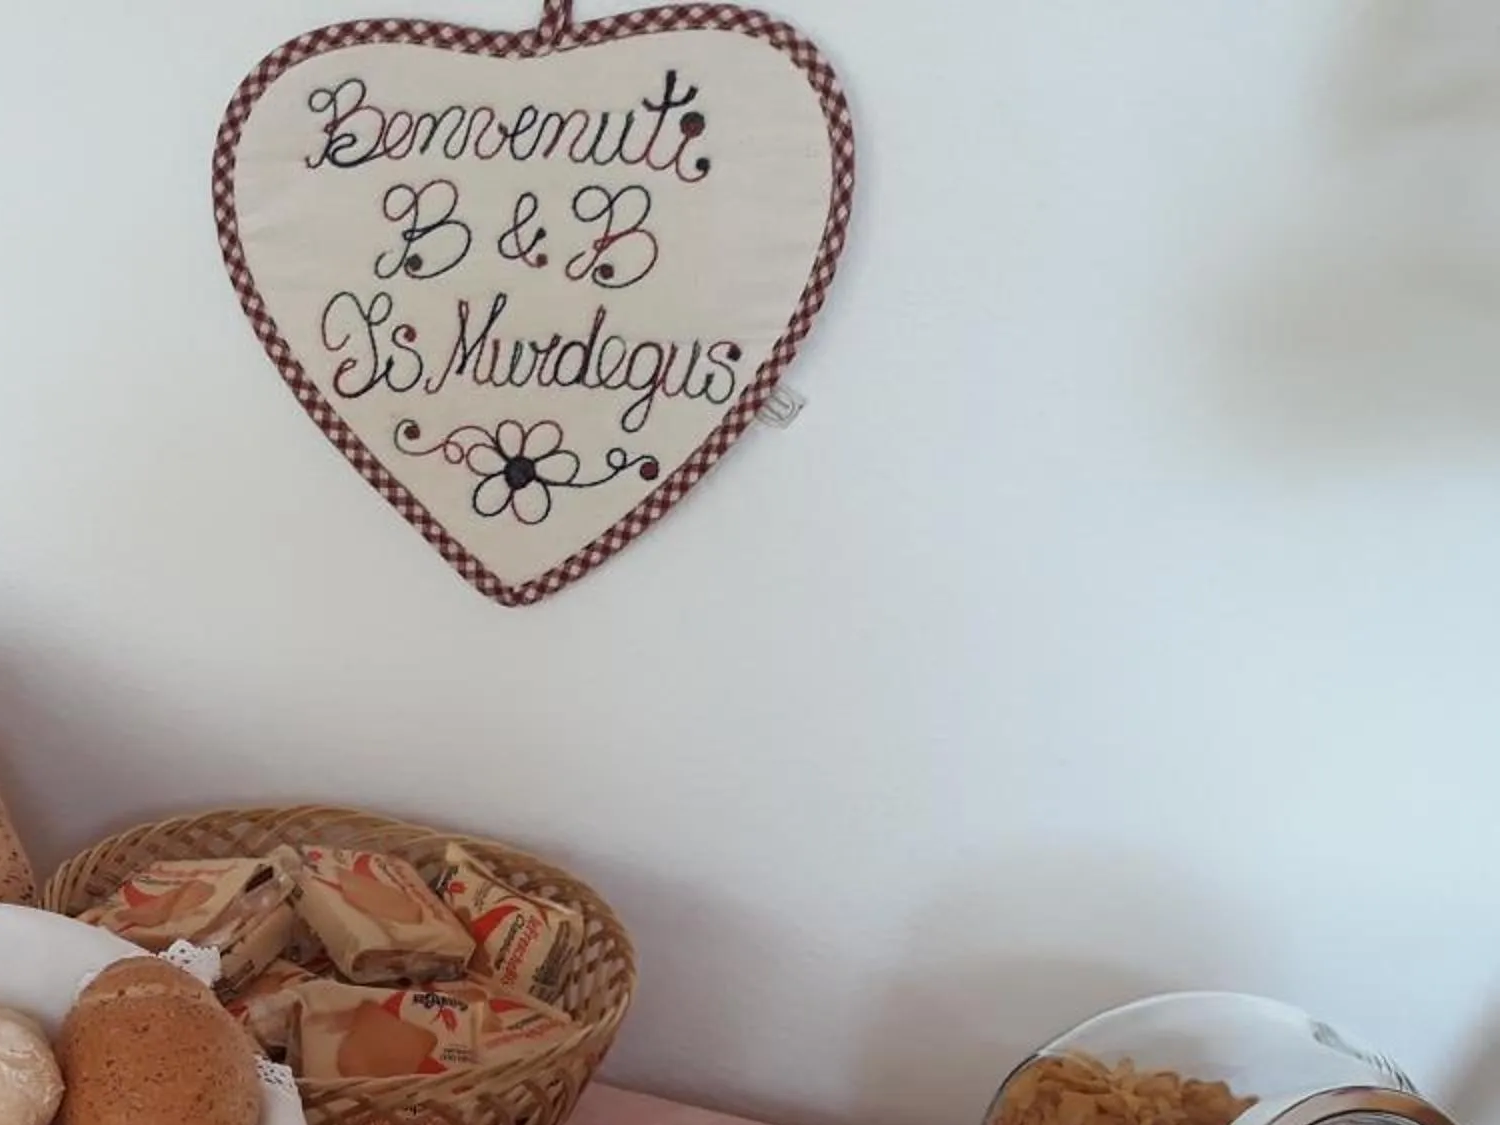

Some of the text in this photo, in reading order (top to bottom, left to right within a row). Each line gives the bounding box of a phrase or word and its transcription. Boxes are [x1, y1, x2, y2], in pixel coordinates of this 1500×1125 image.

[304, 70, 712, 183] Benvenuti
[374, 180, 659, 289] B & B
[423, 292, 742, 433] Murdegus
